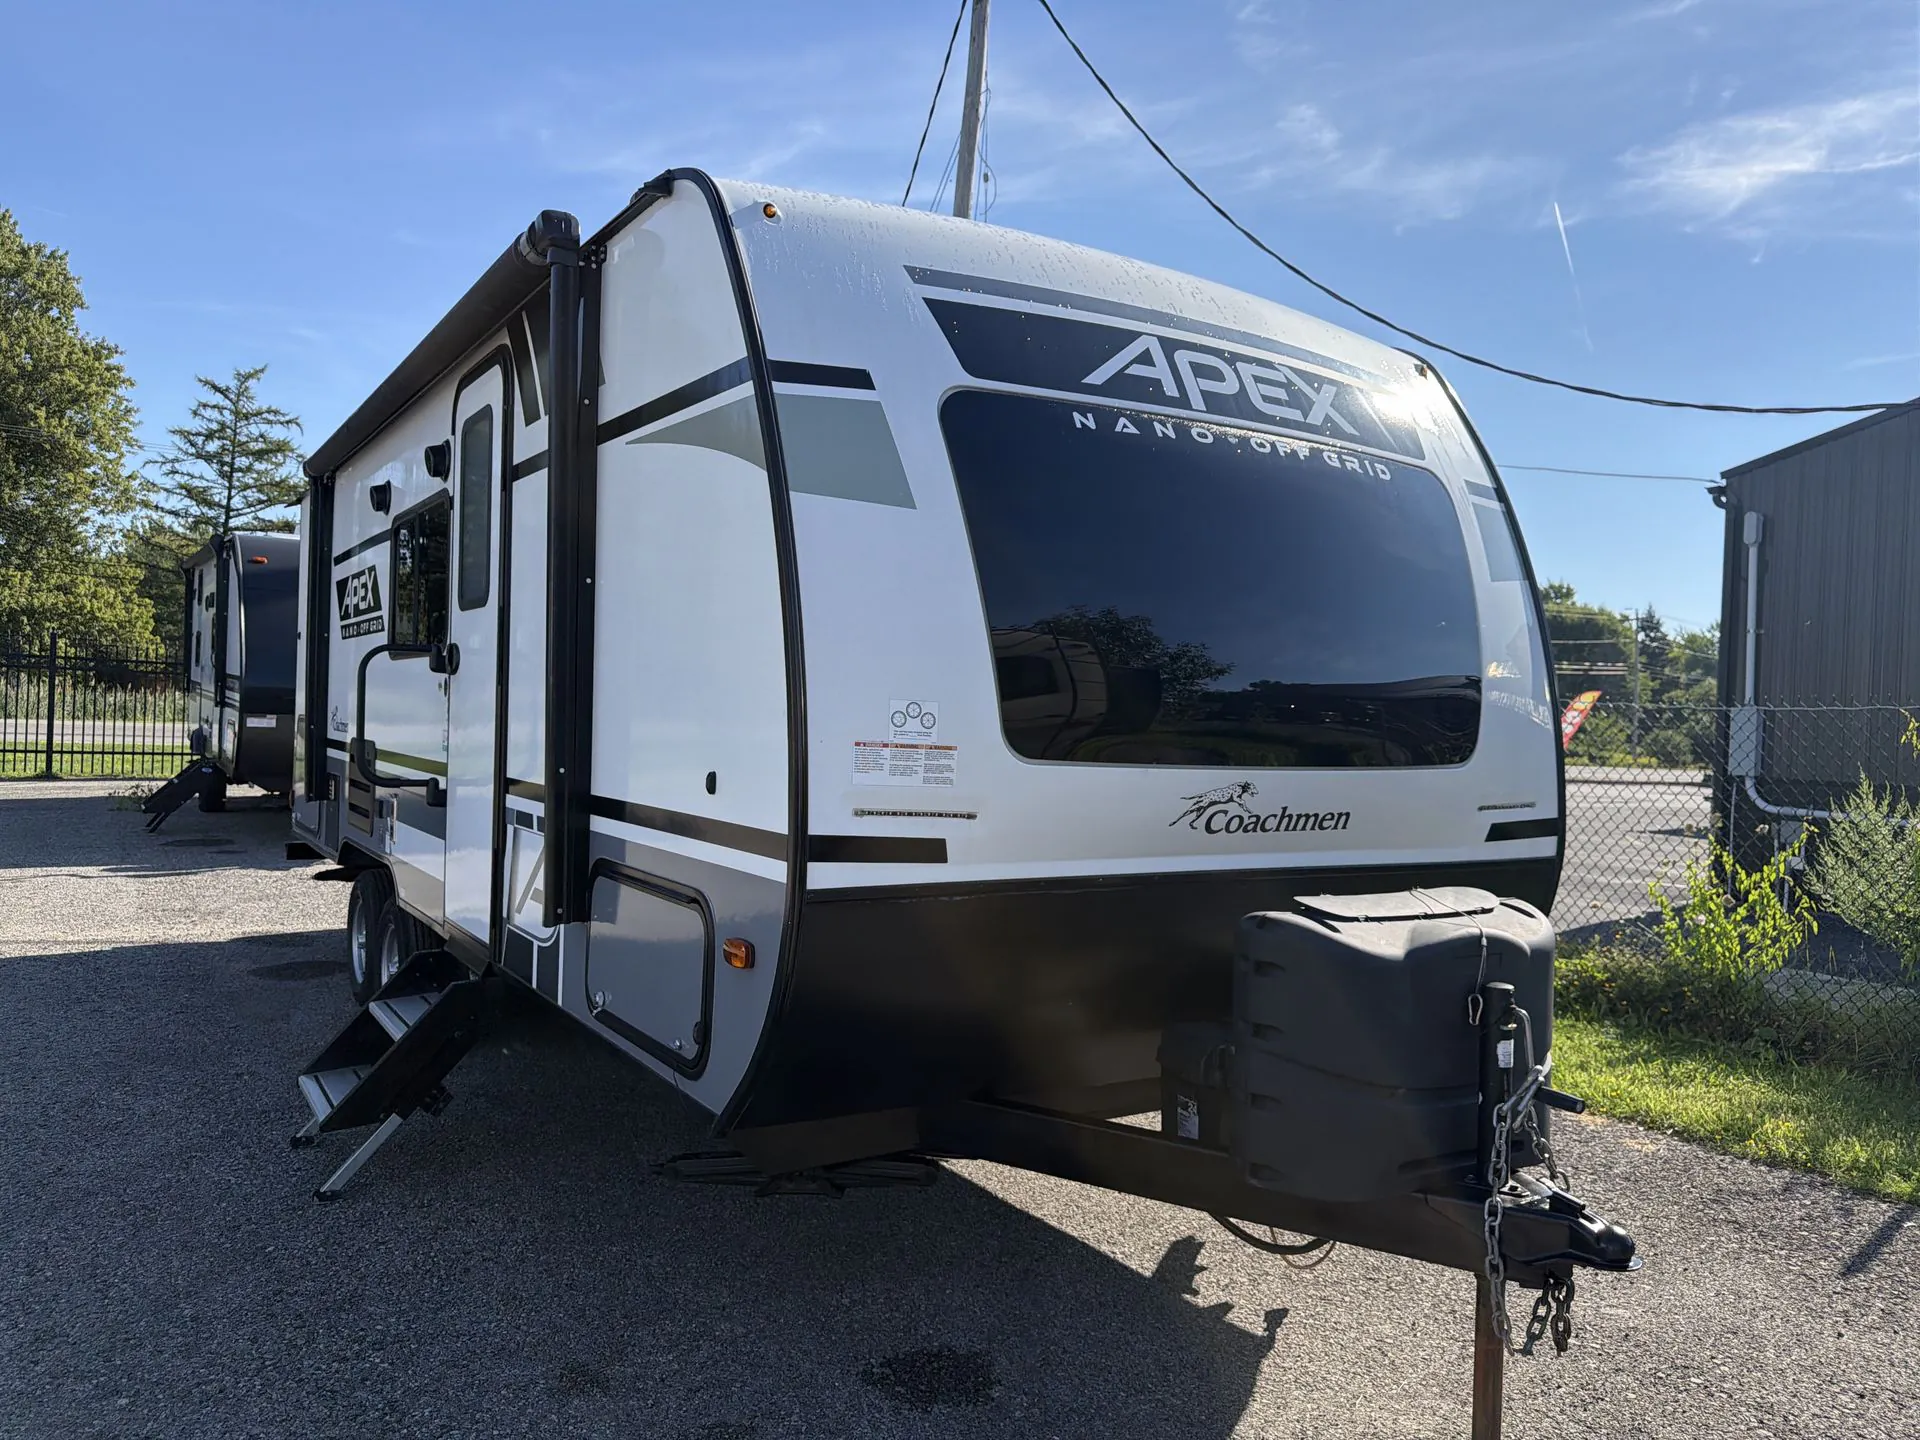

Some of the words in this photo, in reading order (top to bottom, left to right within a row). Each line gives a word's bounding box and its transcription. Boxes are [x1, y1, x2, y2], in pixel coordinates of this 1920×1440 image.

[1081, 334, 1360, 436] APEX
[1073, 411, 1214, 444] NANO
[1322, 451, 1391, 481] GRID
[341, 568, 375, 618] APEX
[1204, 806, 1350, 834] Coachmen
